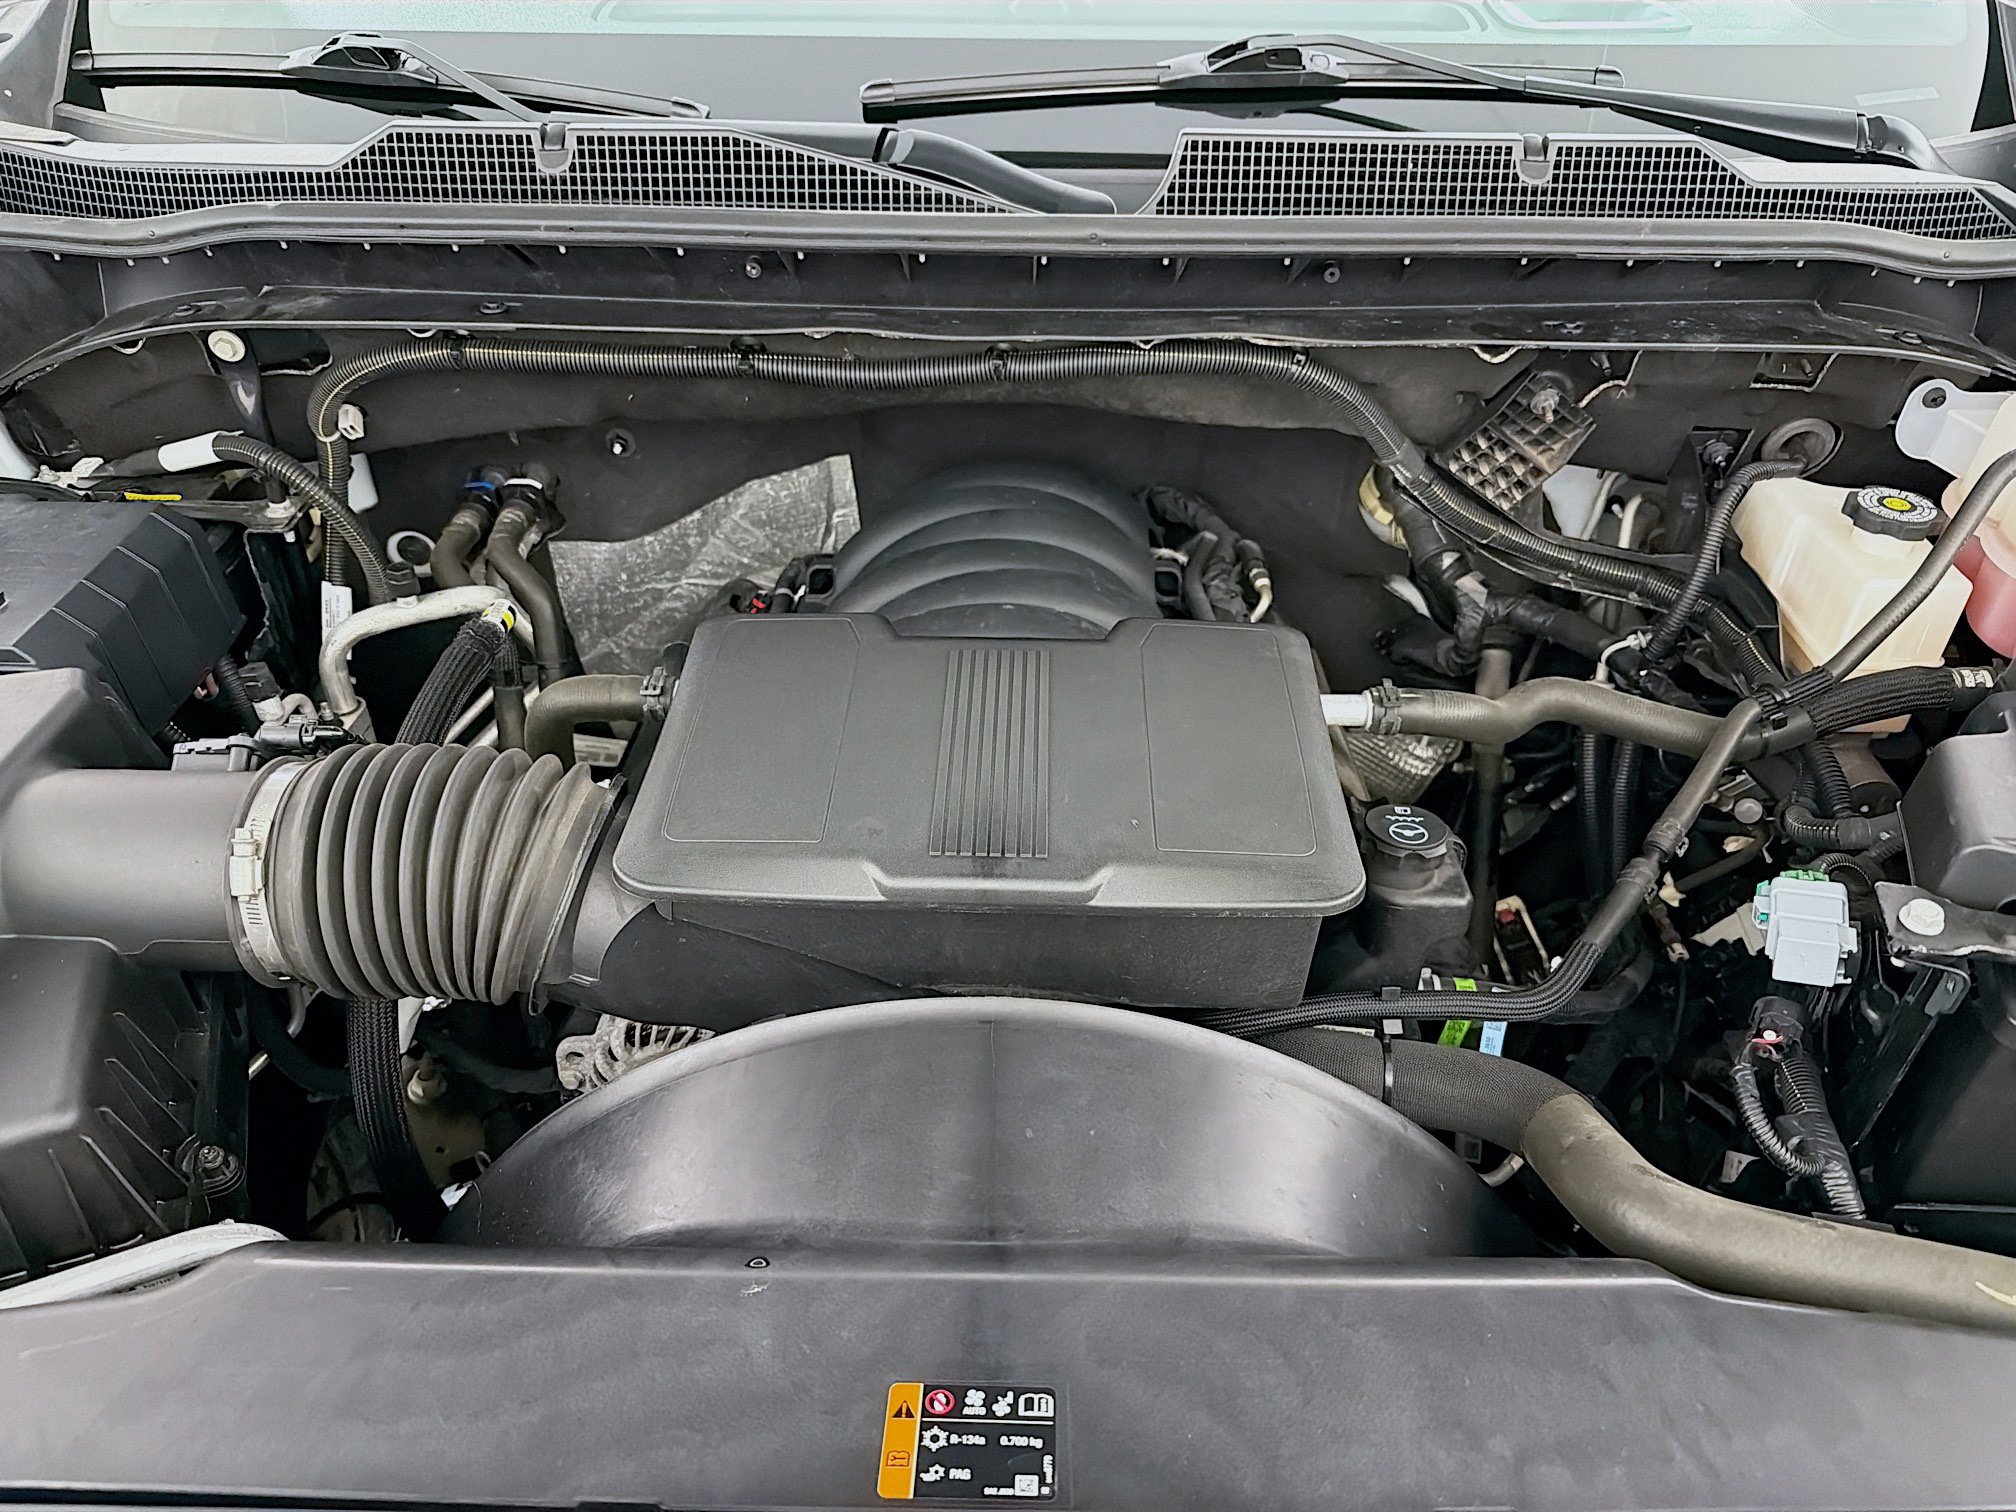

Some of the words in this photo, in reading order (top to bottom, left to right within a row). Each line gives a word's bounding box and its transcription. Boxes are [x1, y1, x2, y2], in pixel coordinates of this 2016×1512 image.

[962, 1406, 987, 1415] AUTO
[949, 1434, 986, 1445] R-134a
[1029, 1436, 1043, 1449] kg
[948, 1468, 972, 1480] PAG
